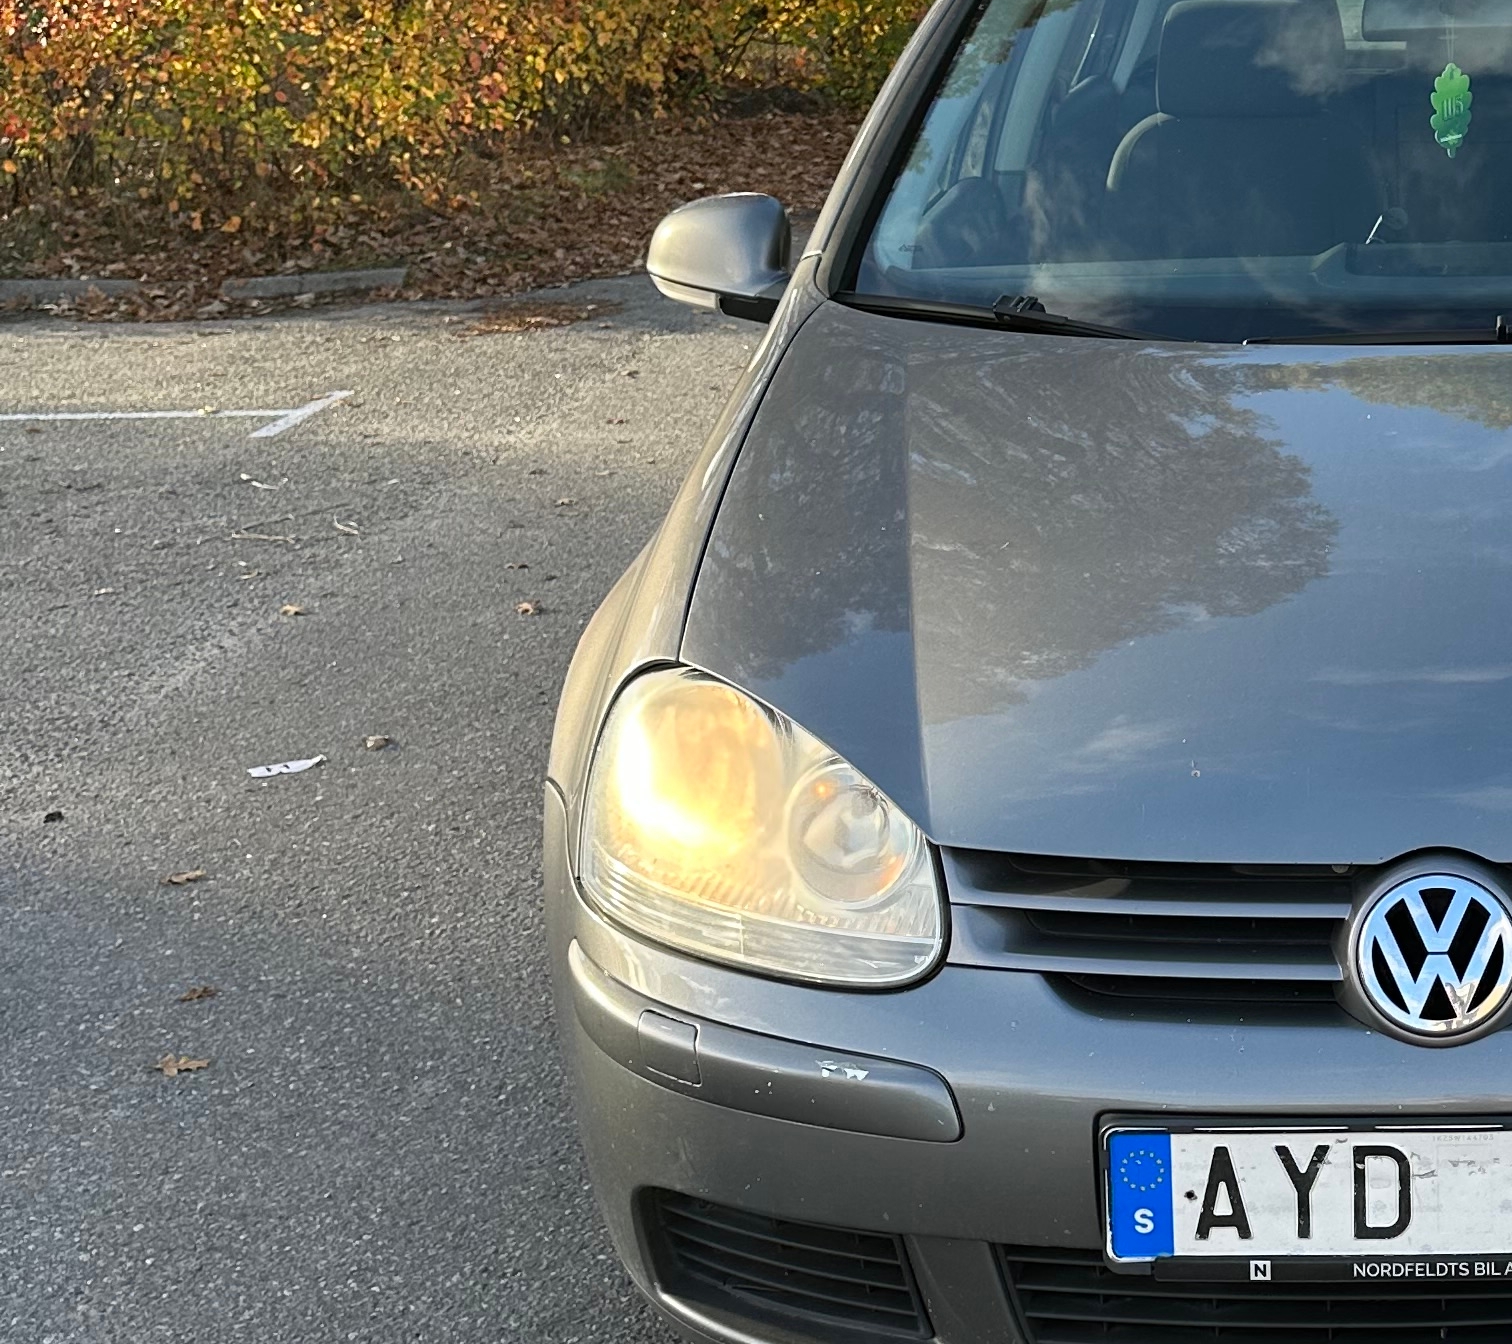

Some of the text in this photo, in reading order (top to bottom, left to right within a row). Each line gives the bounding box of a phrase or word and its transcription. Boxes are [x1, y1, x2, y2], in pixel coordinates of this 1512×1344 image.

[1195, 1144, 1414, 1241] AYD
[1133, 1208, 1155, 1234] S
[1253, 1263, 1268, 1278] N
[1353, 1262, 1470, 1278] NORDFELDTS
[1474, 1261, 1503, 1277] BIL
